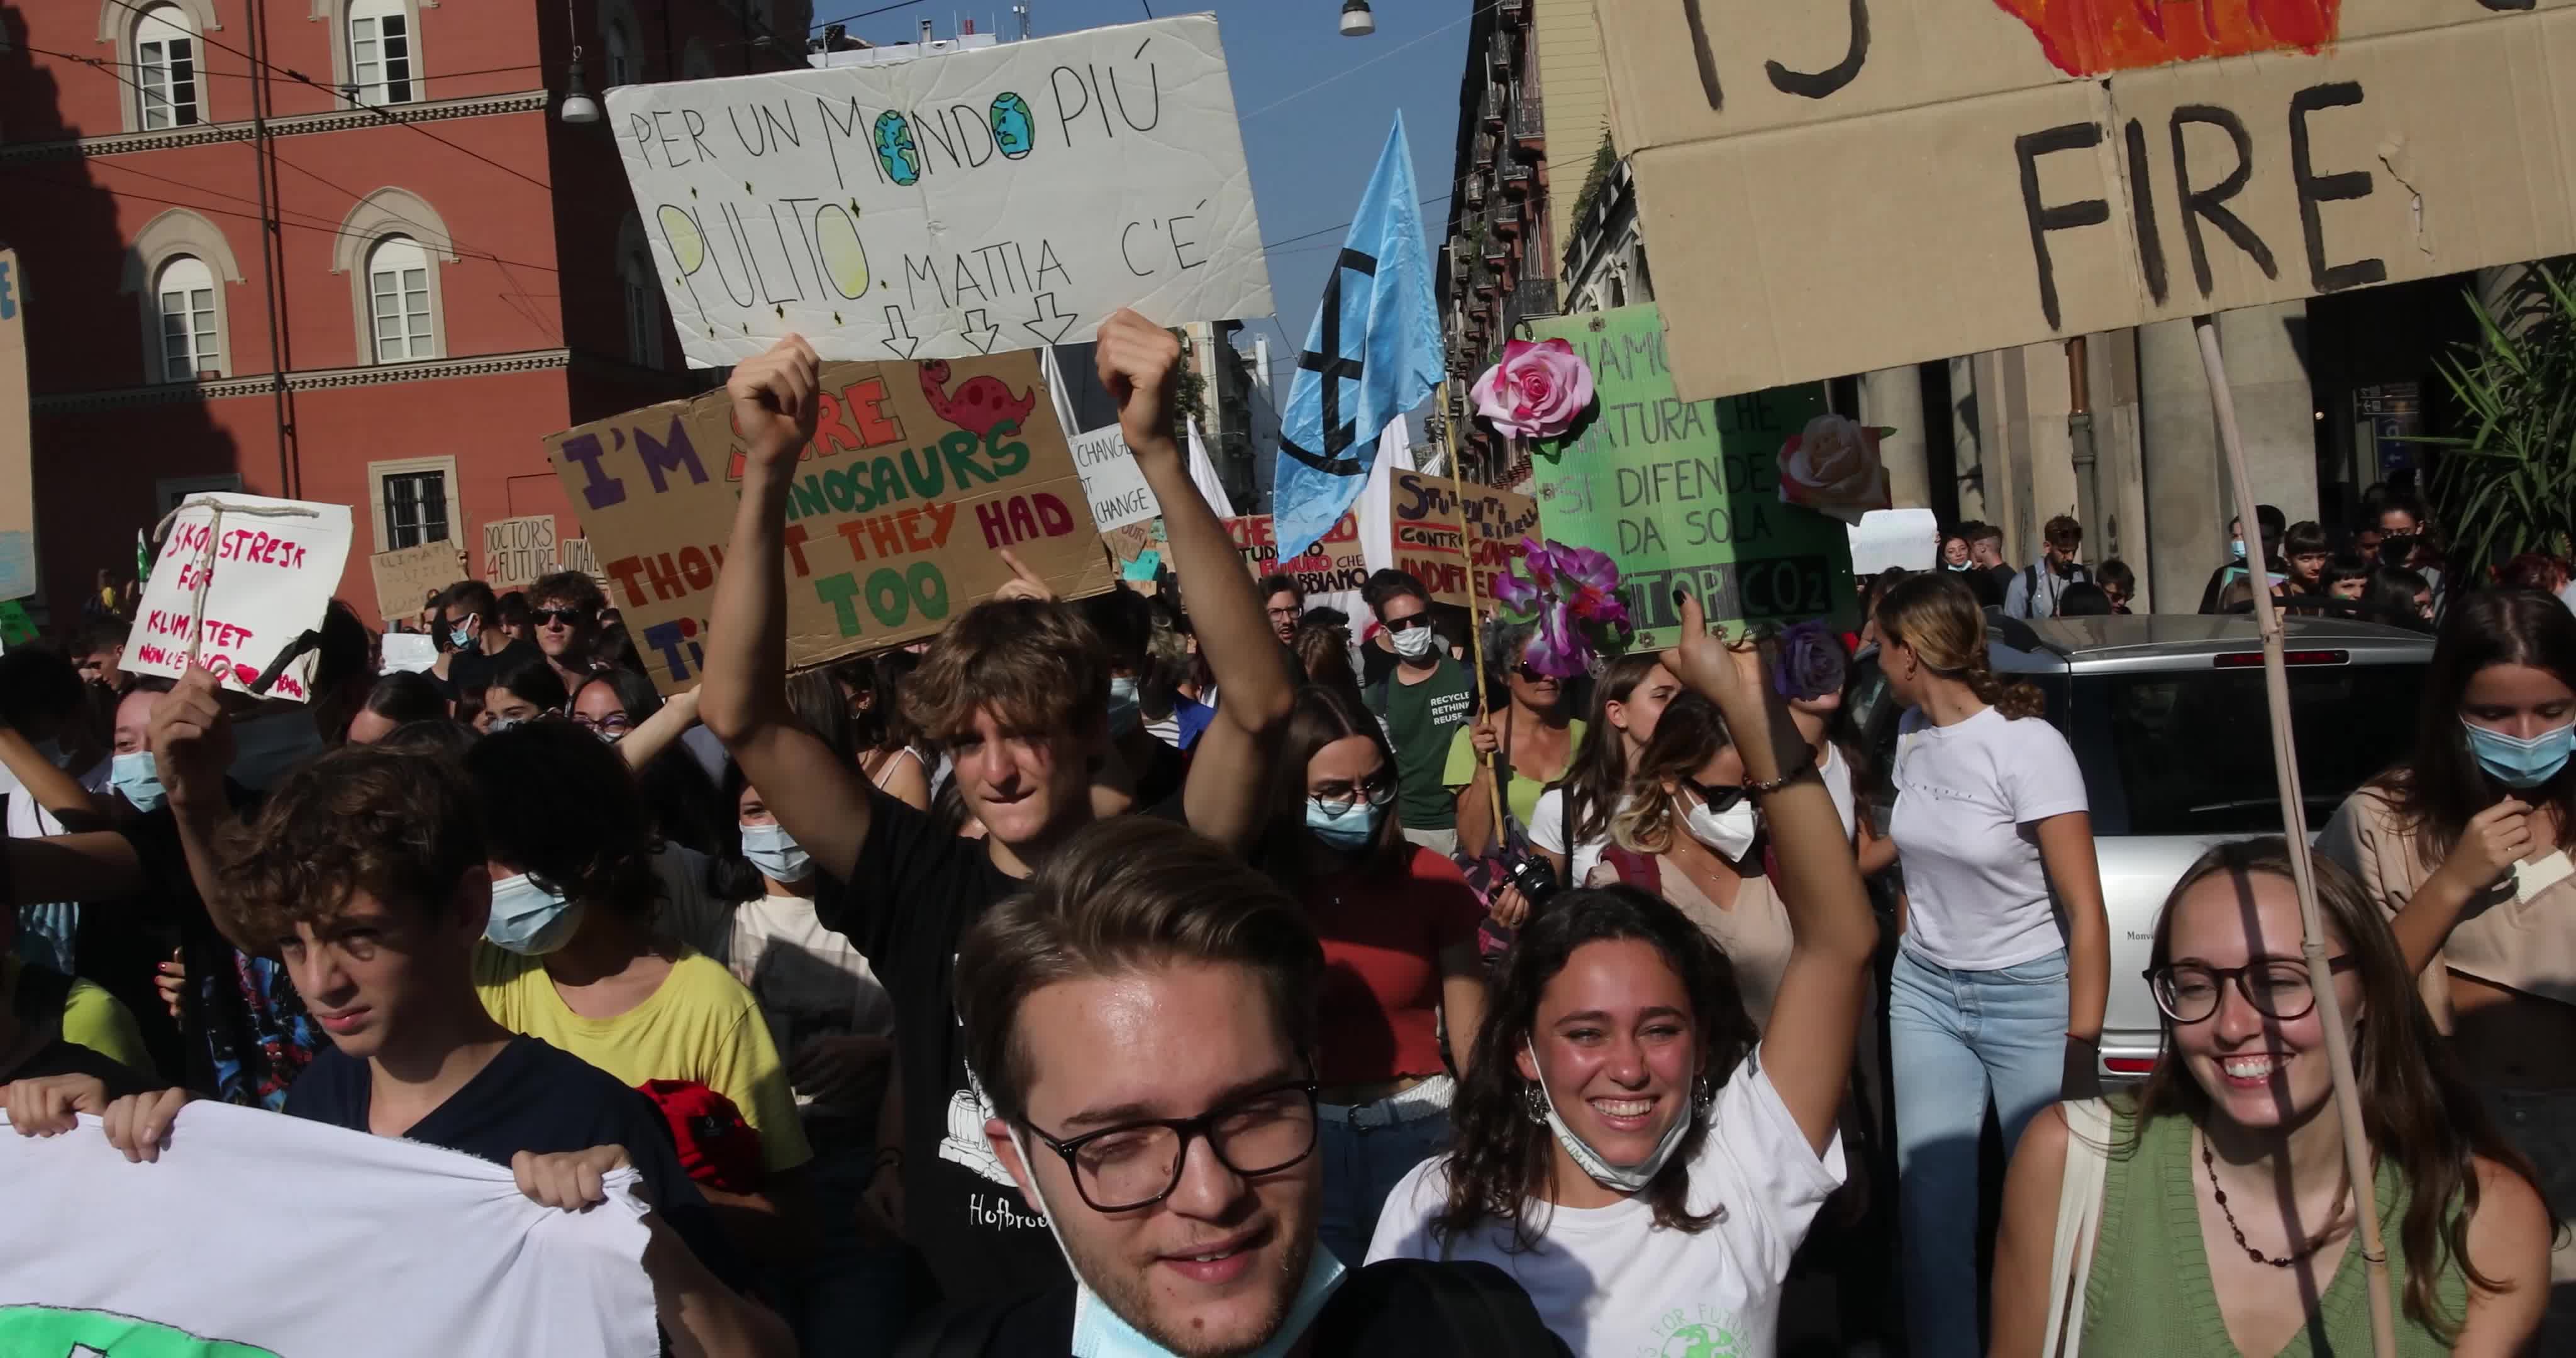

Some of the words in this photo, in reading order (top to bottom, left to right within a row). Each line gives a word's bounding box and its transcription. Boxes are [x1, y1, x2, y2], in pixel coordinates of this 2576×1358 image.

[630, 108, 718, 170] PER
[728, 99, 801, 157] UN
[818, 91, 1036, 190] MONDO
[2015, 80, 2387, 331] FIRE
[657, 197, 870, 323] PULITO
[904, 238, 1072, 311] MATTIA
[560, 414, 709, 511] I'M
[724, 375, 907, 483] RE
[736, 417, 1031, 521] NOSAURS
[1095, 488, 1148, 524] CHANGE
[1617, 453, 1773, 508] DIFENDE
[485, 519, 553, 554] DOCTORS
[838, 502, 957, 561] THEY
[975, 492, 1075, 551] HAD
[1618, 516, 1667, 556] DA
[1685, 504, 1774, 546] SOLA
[1293, 568, 1370, 594] BBIAMO
[1336, 554, 1364, 568] CHE
[814, 561, 950, 639] TOO
[1629, 569, 1724, 624] TOP
[1430, 692, 1470, 707] RECYCLE
